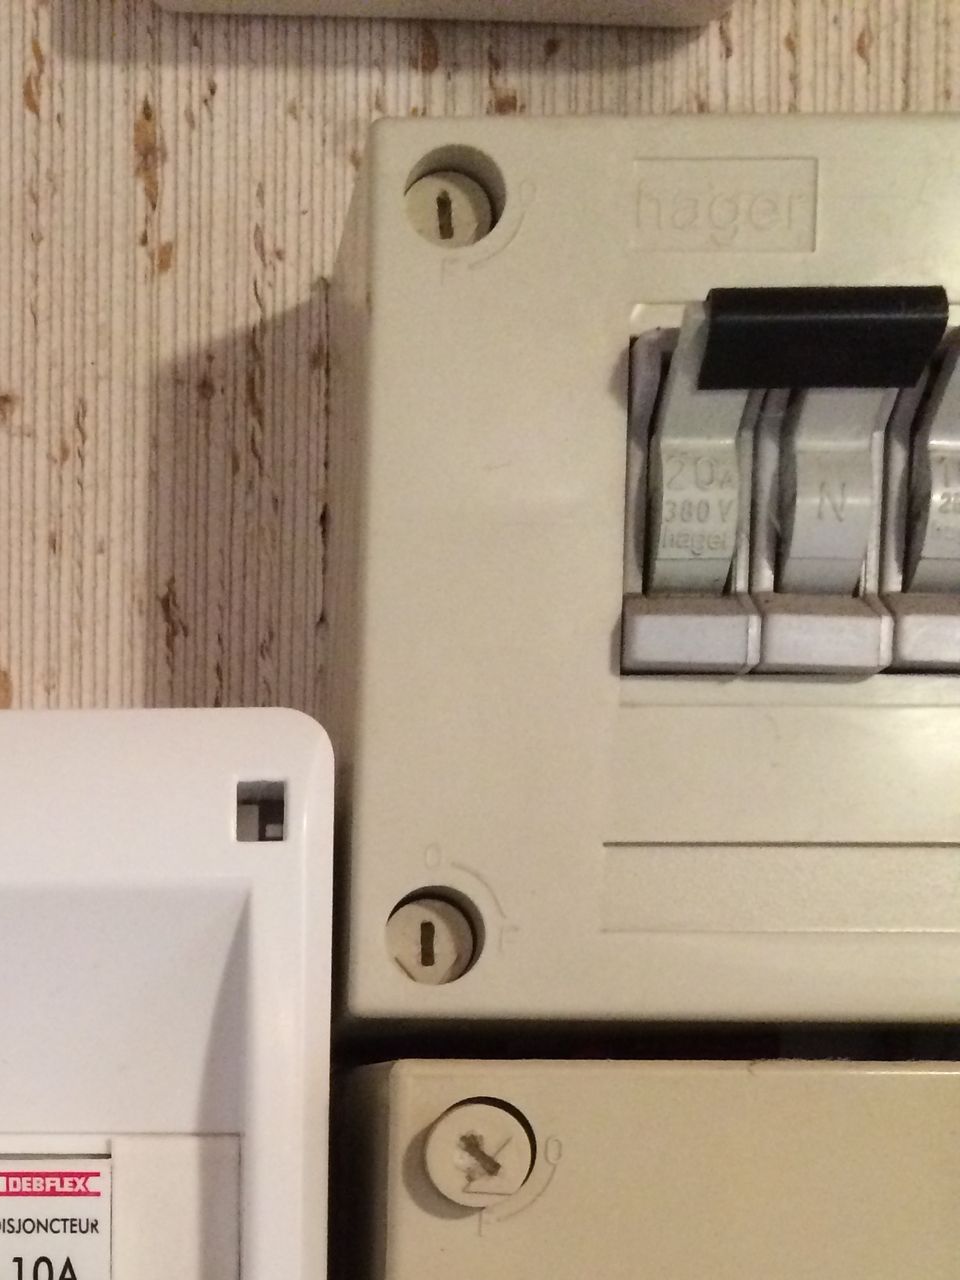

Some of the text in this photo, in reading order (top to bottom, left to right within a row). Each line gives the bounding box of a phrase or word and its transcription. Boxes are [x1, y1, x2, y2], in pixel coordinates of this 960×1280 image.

[636, 180, 808, 247] hager
[664, 499, 711, 523] 380
[817, 481, 846, 522] N
[7, 1176, 89, 1193] DEBFLEX
